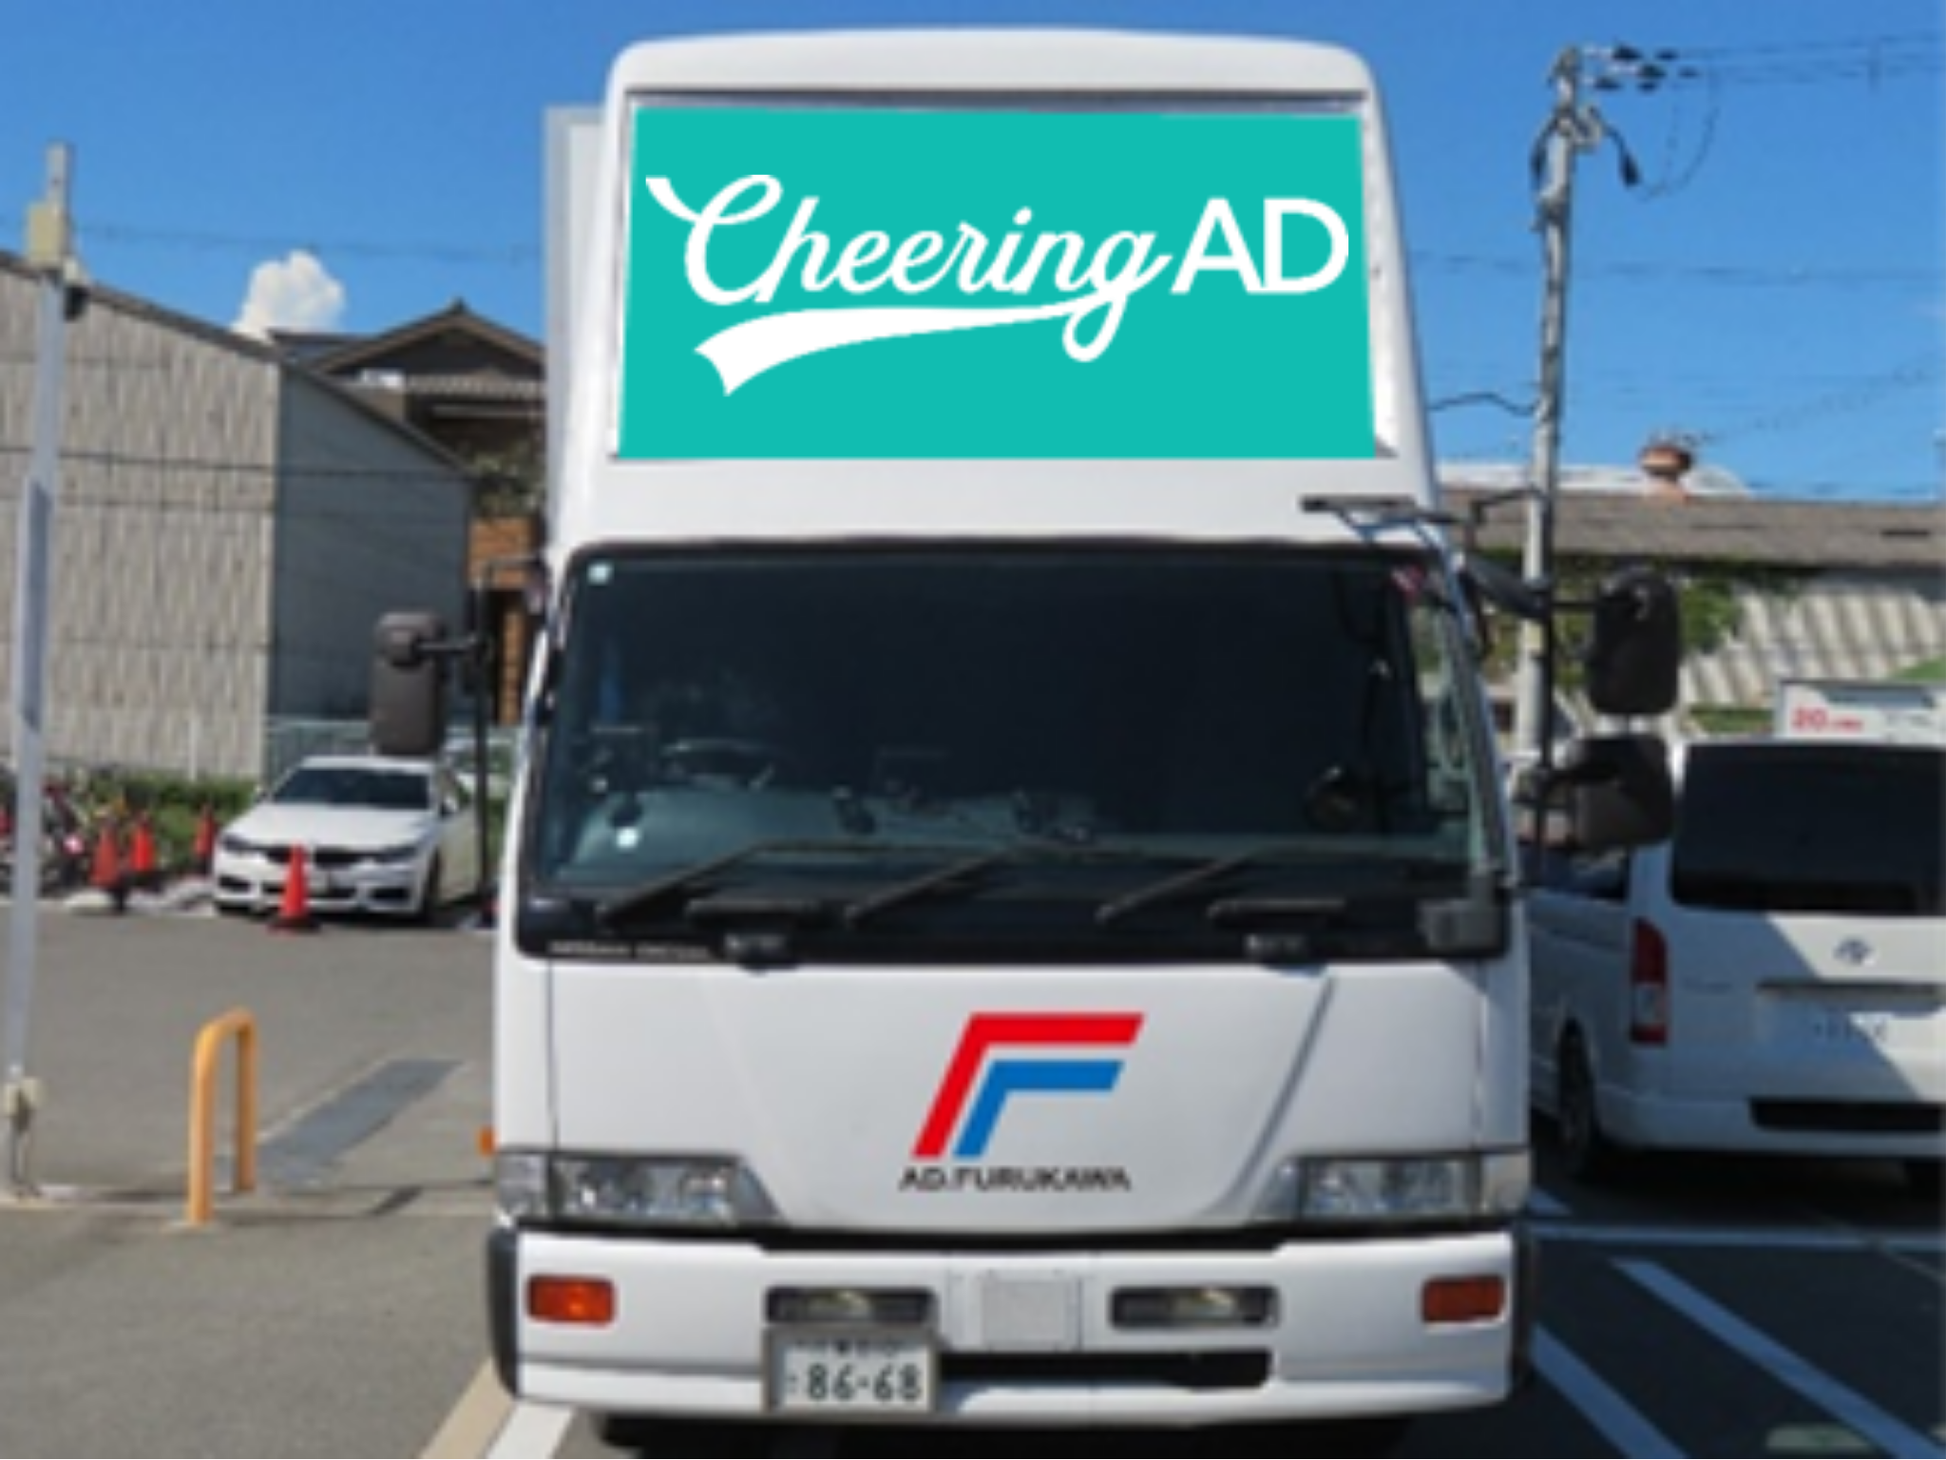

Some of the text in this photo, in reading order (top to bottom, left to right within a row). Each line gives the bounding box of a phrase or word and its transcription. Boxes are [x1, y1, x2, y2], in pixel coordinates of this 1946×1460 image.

[646, 175, 1349, 395] Cheering AD
[807, 1362, 922, 1402] 86-68
